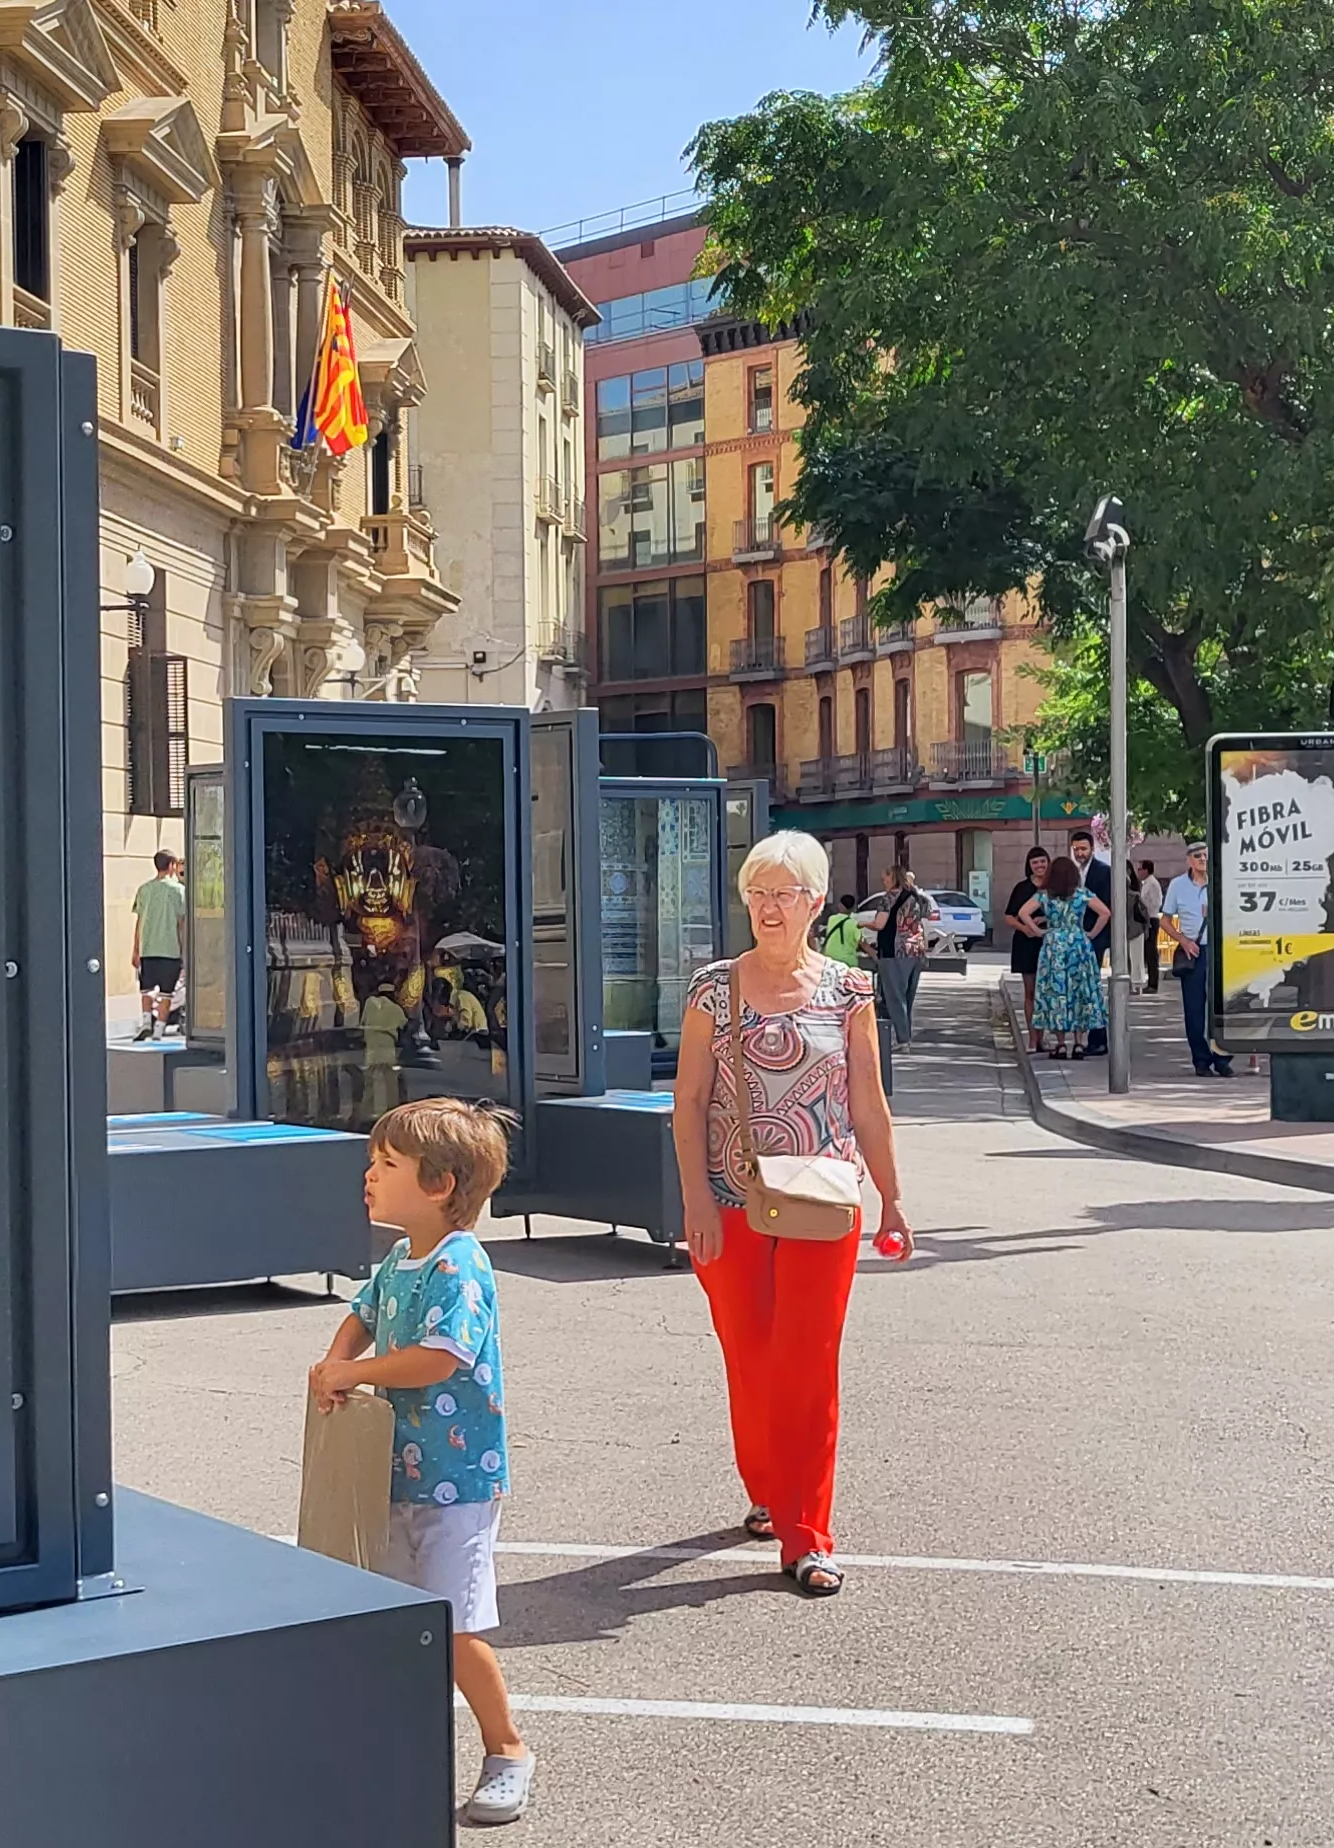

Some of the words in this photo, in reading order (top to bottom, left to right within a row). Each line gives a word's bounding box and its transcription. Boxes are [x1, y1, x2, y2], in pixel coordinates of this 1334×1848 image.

[1237, 797, 1302, 830] FIBRA
[1239, 821, 1313, 856] MÓVIL
[1239, 891, 1276, 912] 37
